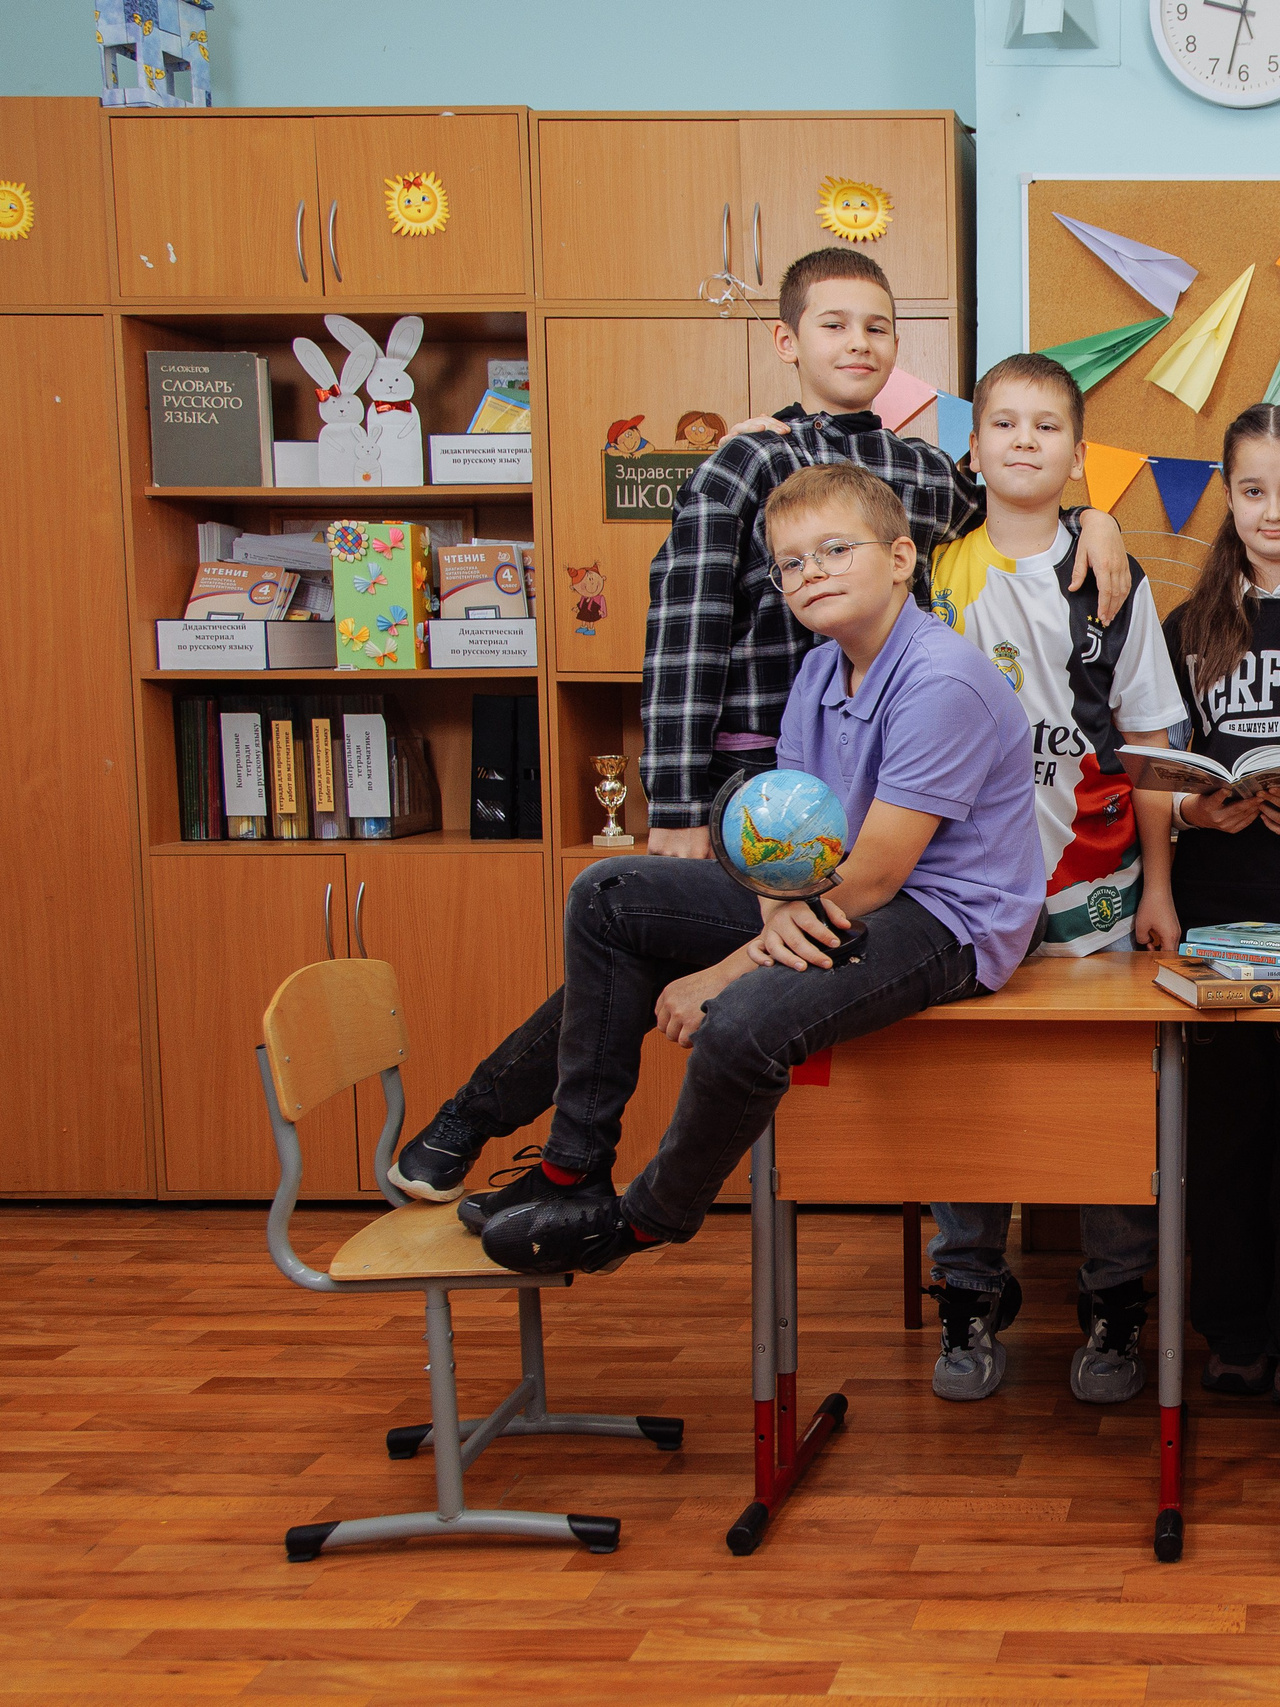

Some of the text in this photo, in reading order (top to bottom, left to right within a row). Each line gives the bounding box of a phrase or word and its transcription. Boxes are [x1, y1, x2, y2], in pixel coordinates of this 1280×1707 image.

[1176, 3, 1188, 21] 9
[1185, 34, 1197, 53] 8
[1209, 58, 1220, 75] 7
[1267, 55, 1279, 73] 5
[1238, 64, 1250, 82] 6
[162, 379, 233, 393] СЛОВАРЬ
[162, 395, 243, 410] РУССКОГО
[164, 410, 220, 425] ЯЗЫКА
[463, 457, 497, 465] русскому
[498, 457, 521, 465] языку
[616, 484, 678, 510] ШКО
[443, 553, 487, 564] ЧТЕНИЕ
[203, 567, 249, 578] ЧТЕНИЕ
[502, 568, 513, 582] 4
[258, 584, 271, 596] 4
[181, 622, 247, 632] Дидактический
[458, 627, 524, 636] Дидактический
[188, 643, 227, 652] русскому
[228, 643, 254, 652] языку
[468, 638, 508, 646] материал
[462, 648, 500, 657] русскому
[501, 648, 527, 656] языку
[1228, 722, 1236, 731] IS
[1237, 721, 1266, 733] ALWAYS
[1267, 721, 1279, 733] MY
[274, 723, 283, 769] проверочных
[1031, 718, 1087, 758] tes
[253, 722, 265, 798] по русскому языку
[284, 731, 292, 772] математике
[234, 732, 243, 789] Контрольные
[244, 744, 253, 777] тетради
[346, 733, 354, 789] Контрольные
[355, 744, 364, 778] тетради
[364, 730, 373, 791] по математике
[286, 773, 292, 782] по
[1089, 888, 1117, 906] SPORTING
